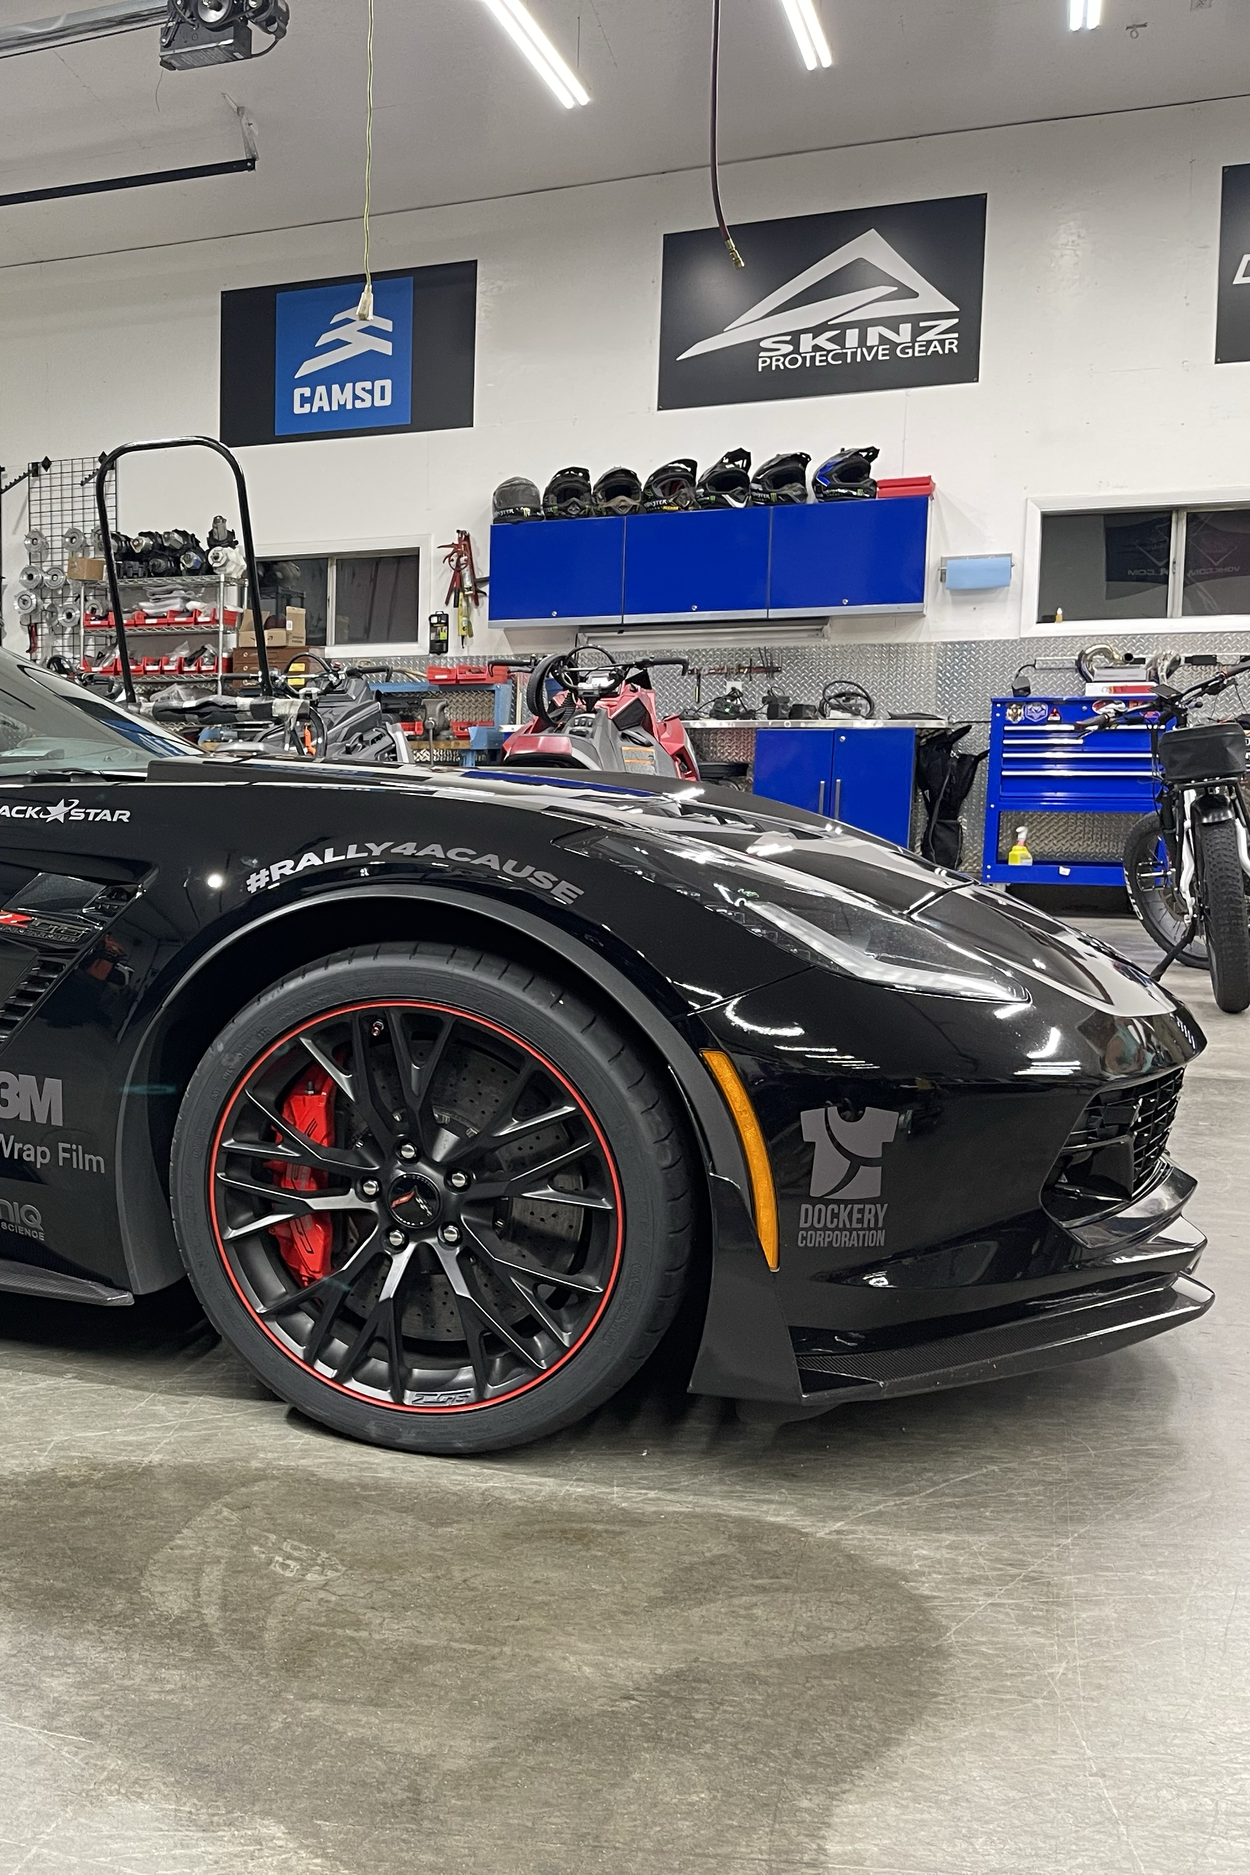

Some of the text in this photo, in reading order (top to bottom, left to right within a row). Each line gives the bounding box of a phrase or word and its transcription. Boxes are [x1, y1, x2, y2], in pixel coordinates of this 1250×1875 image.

[759, 318, 960, 357] SKINZ
[758, 338, 959, 372] PROTECTIVE GEAR
[293, 379, 392, 415] CAMSO
[68, 808, 131, 823] STAR
[246, 841, 585, 905] #RALLY4ACAUSE
[58, 1142, 105, 1174] Film
[1, 1222, 45, 1242] SCIENCE
[799, 1203, 889, 1229] DOCKERY
[797, 1229, 885, 1248] CORPORATION
